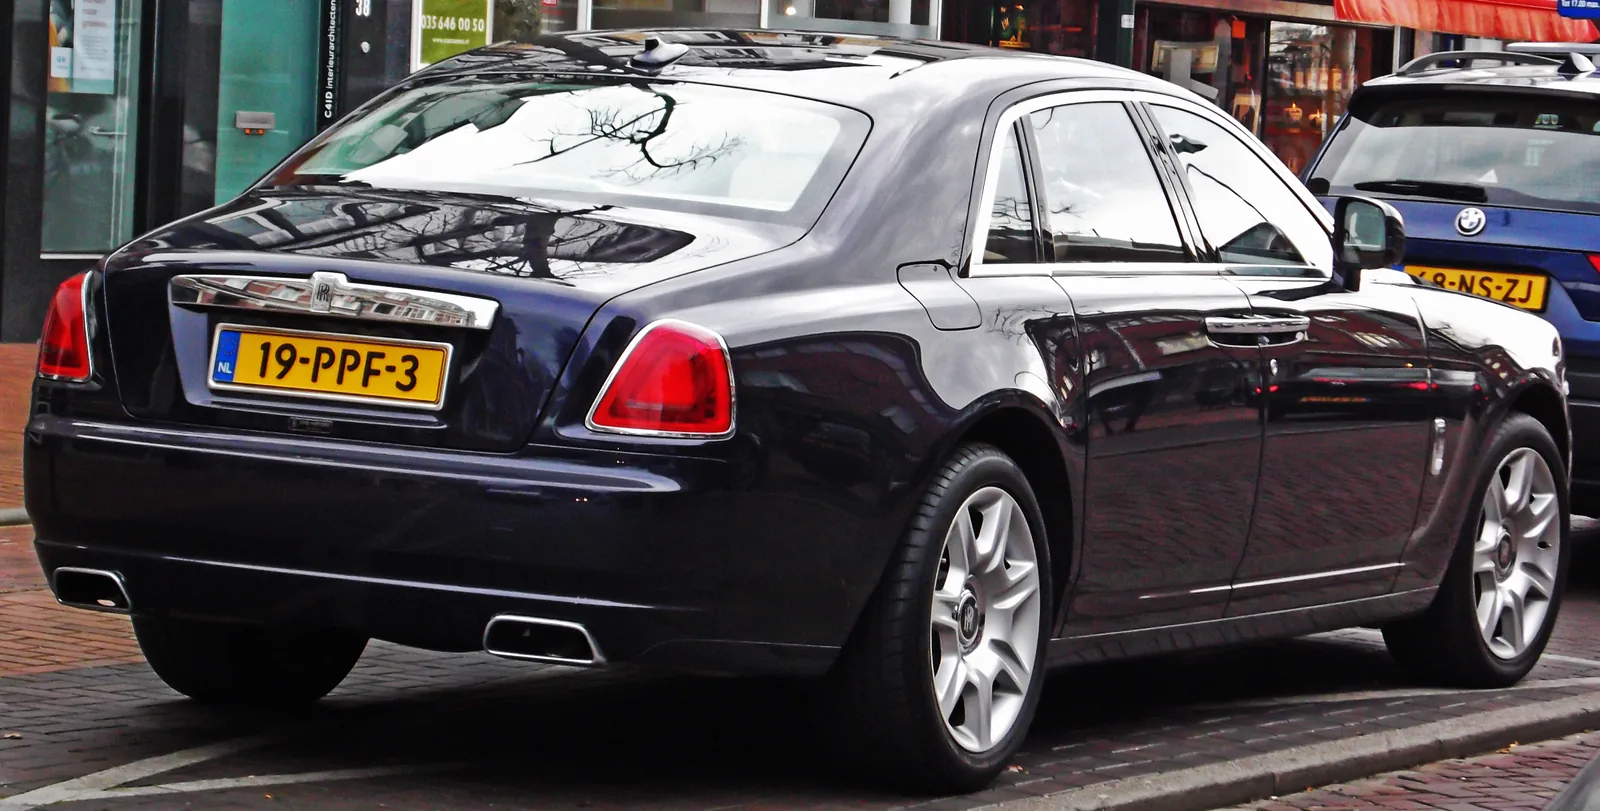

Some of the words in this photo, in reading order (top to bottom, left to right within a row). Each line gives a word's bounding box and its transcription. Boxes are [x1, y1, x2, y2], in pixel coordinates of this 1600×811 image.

[355, 0, 371, 17] 38
[421, 15, 437, 29] 035
[438, 16, 456, 31] 646
[458, 17, 470, 31] 00
[472, 18, 485, 32] 50
[324, 91, 333, 119] C4ID
[217, 361, 233, 375] NL
[258, 341, 419, 392] 19-PPF-3
